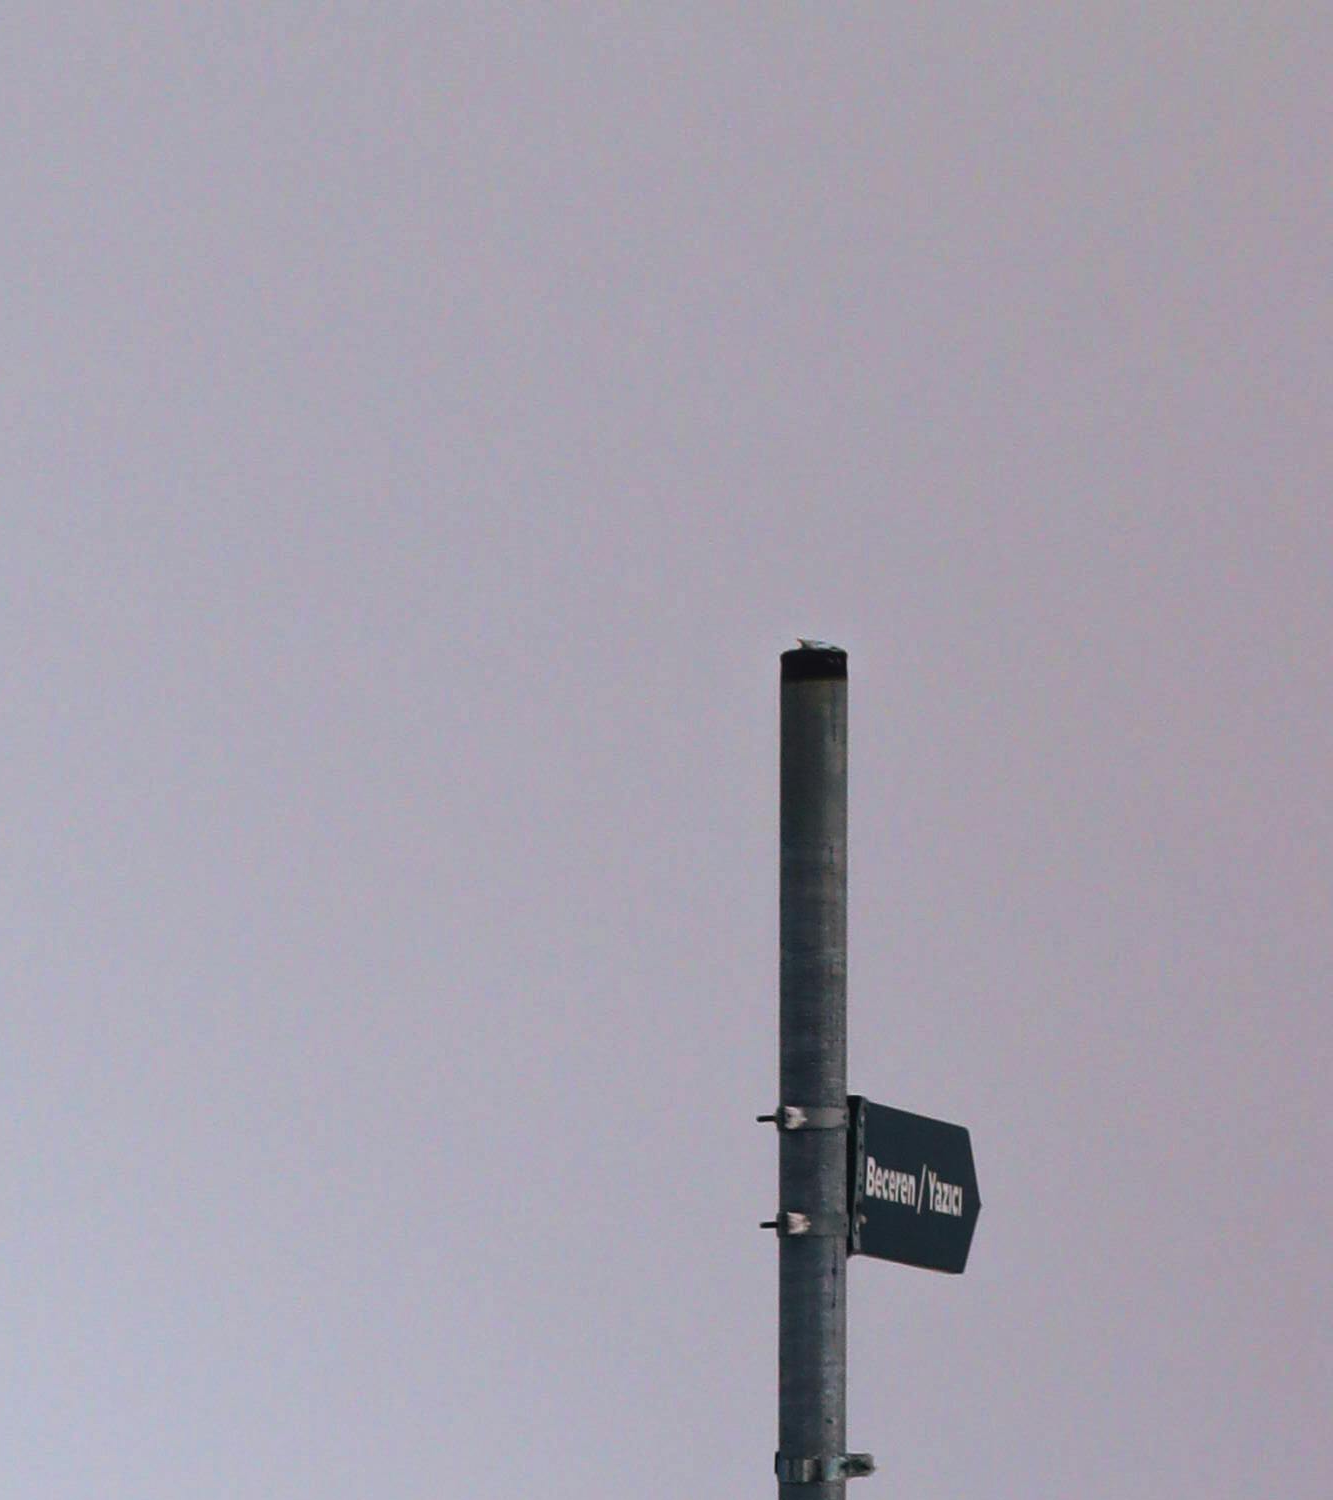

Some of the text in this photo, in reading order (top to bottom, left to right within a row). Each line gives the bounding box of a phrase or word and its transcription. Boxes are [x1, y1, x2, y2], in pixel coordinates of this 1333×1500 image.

[866, 1156, 963, 1217] Beceren / Yazıcı
